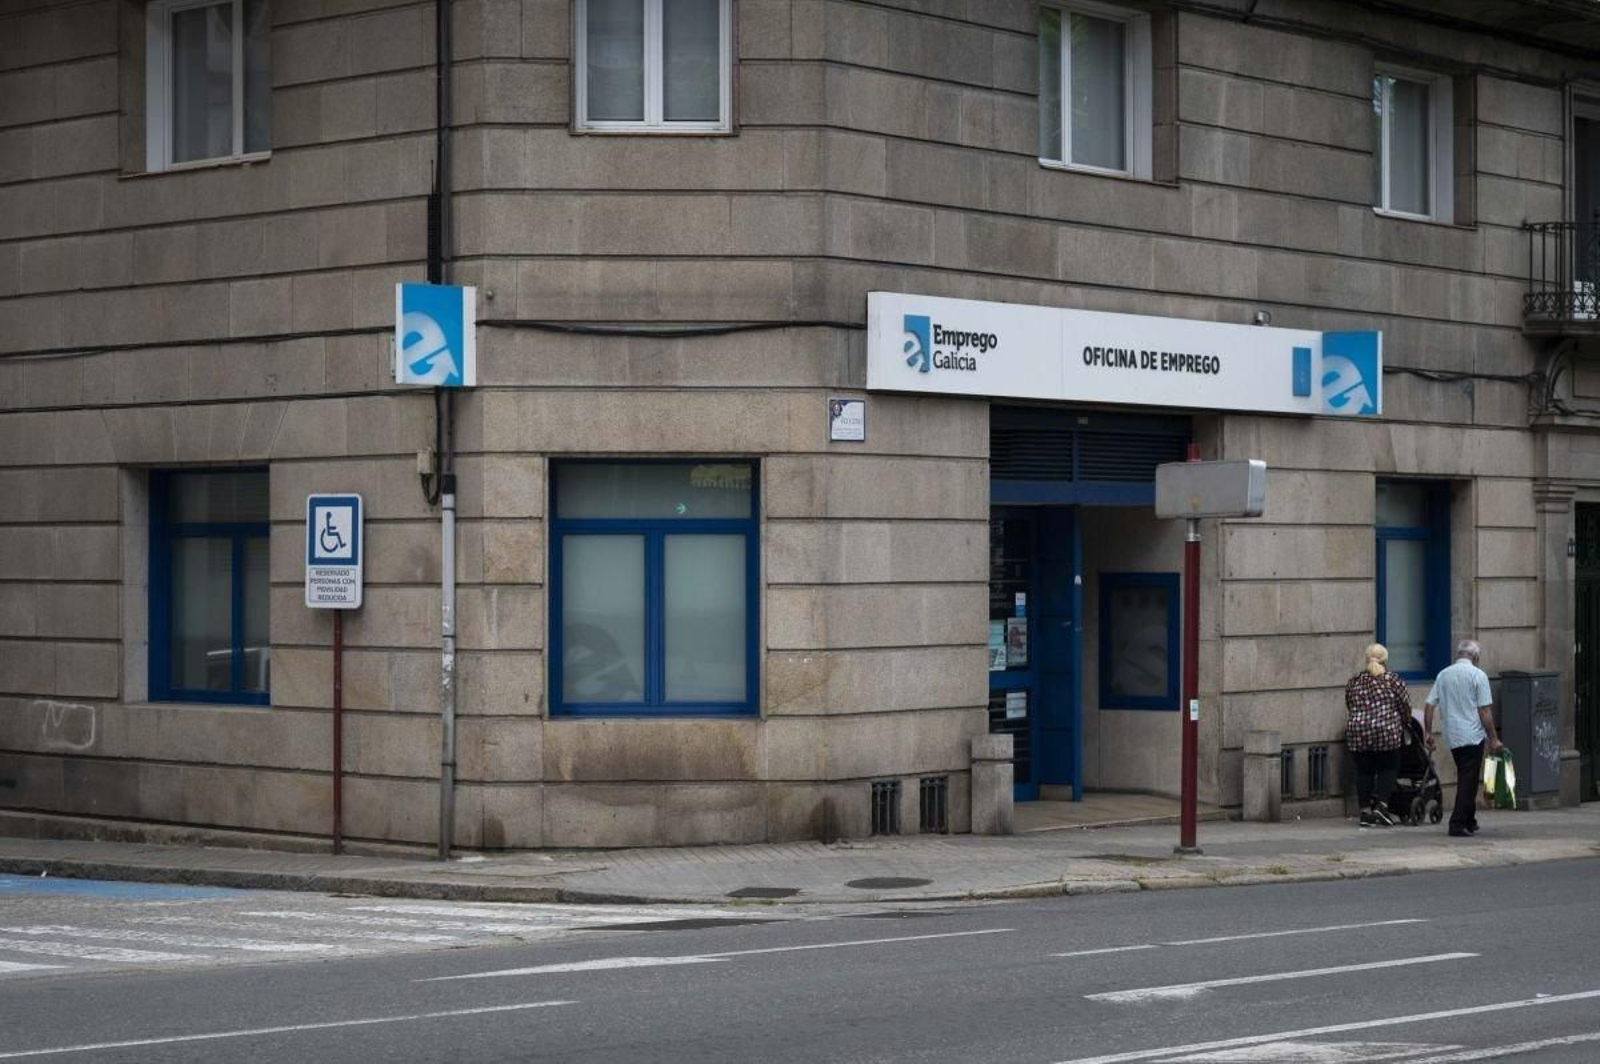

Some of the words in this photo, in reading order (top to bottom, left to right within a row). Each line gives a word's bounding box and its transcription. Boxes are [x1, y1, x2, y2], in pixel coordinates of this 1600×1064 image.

[932, 323, 998, 353] Emprego
[932, 350, 977, 371] Galicia
[1083, 346, 1138, 369] OFICINA
[1140, 350, 1158, 370] DE
[1160, 352, 1221, 375] EMPREGO
